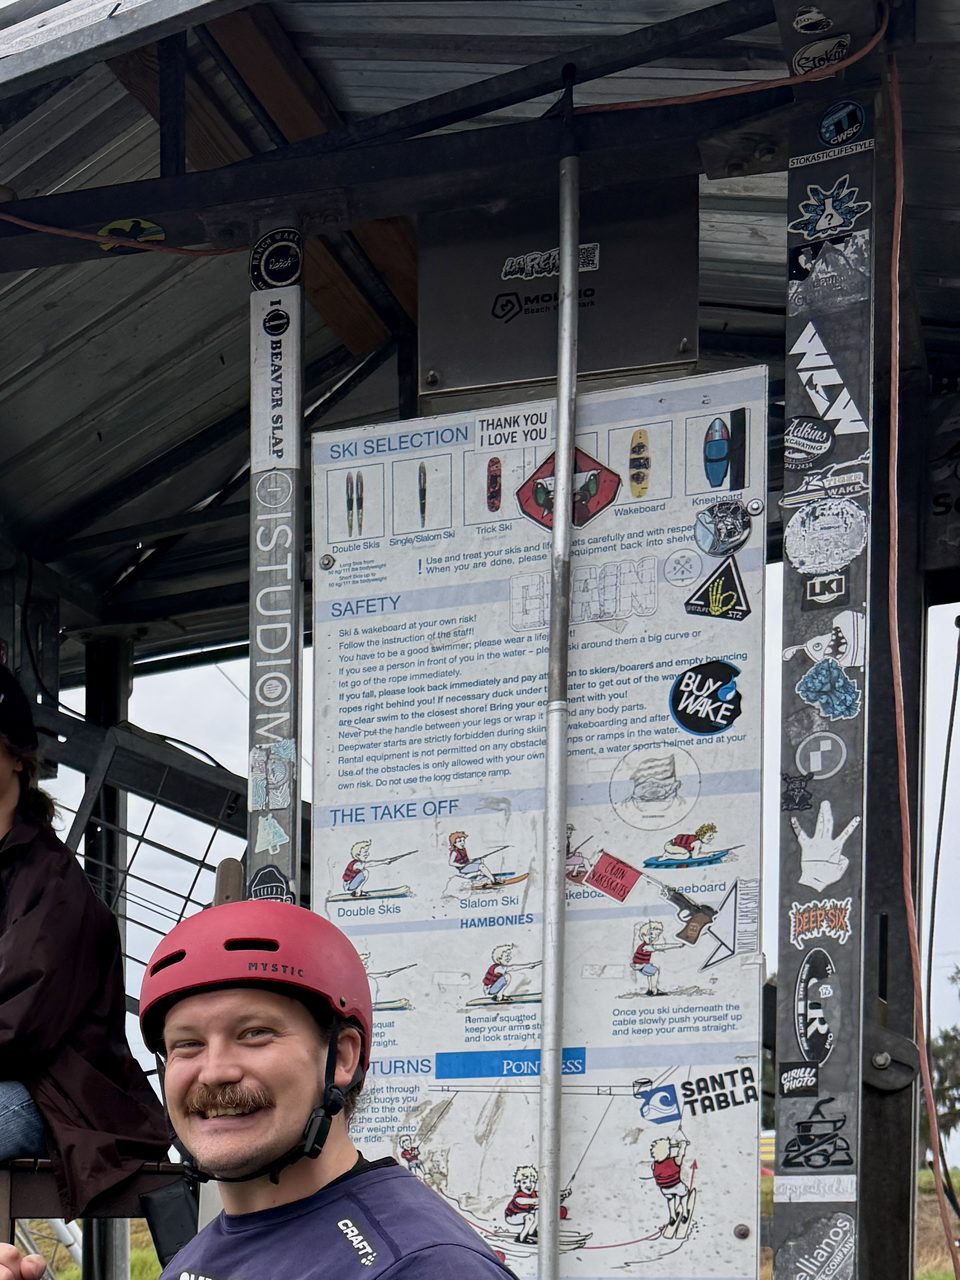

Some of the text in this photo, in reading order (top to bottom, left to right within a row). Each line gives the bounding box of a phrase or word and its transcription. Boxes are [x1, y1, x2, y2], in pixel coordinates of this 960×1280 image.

[790, 140, 874, 167] STOKASTICLIFESTYLE
[271, 339, 283, 413] BEAVER
[478, 411, 547, 433] THANK YOU
[784, 419, 827, 442] Adkins
[271, 414, 284, 460] SLAP
[330, 425, 468, 460] SKI SELECTION
[480, 426, 546, 447] I LOVE YOU
[784, 437, 824, 453] XCAVATING
[691, 491, 742, 507] Kneeboard
[827, 483, 862, 497] WAKE
[613, 502, 666, 517] Wakeboard
[388, 531, 442, 548] Single/Slalom
[442, 529, 455, 539] Ski
[475, 522, 512, 535] Trick Ski
[587, 526, 664, 546] carefully and with
[332, 539, 380, 554] Double Skis
[425, 542, 540, 565] Use and treat your skis and
[570, 536, 663, 558] equipment back into
[425, 551, 548, 575] When you are done, please
[331, 594, 400, 618] SAFETY
[338, 613, 477, 637] Ski & wakeboard at your own risk!
[338, 626, 474, 650] Follow the instruction of the staff!
[680, 671, 721, 696] BUY
[677, 691, 734, 725] WAKE
[329, 798, 459, 827] THE TAKE OFF
[337, 902, 401, 917] Double Skis
[458, 894, 518, 909] Slalom Ski
[460, 911, 534, 929] HAMBONIES
[795, 906, 847, 935] DEEP SIX
[247, 961, 305, 978] MYSTIC
[612, 1002, 740, 1017] Once you ski underneath the
[612, 1012, 742, 1026] cable slowly push yourself up
[464, 1021, 530, 1034] keep your arms
[464, 1032, 536, 1042] and look straight
[611, 1022, 737, 1036] and keep your arms straight.
[680, 1067, 755, 1098] SANTA
[780, 1067, 816, 1086] CIRILLI
[783, 1076, 817, 1094] PHOTO
[386, 1084, 420, 1096] through
[684, 1085, 759, 1116] TABLA
[374, 1114, 401, 1124] cable.
[366, 1124, 417, 1135] weight onto
[337, 1218, 376, 1258] CRAFT
[825, 1237, 855, 1276] COMPANY
